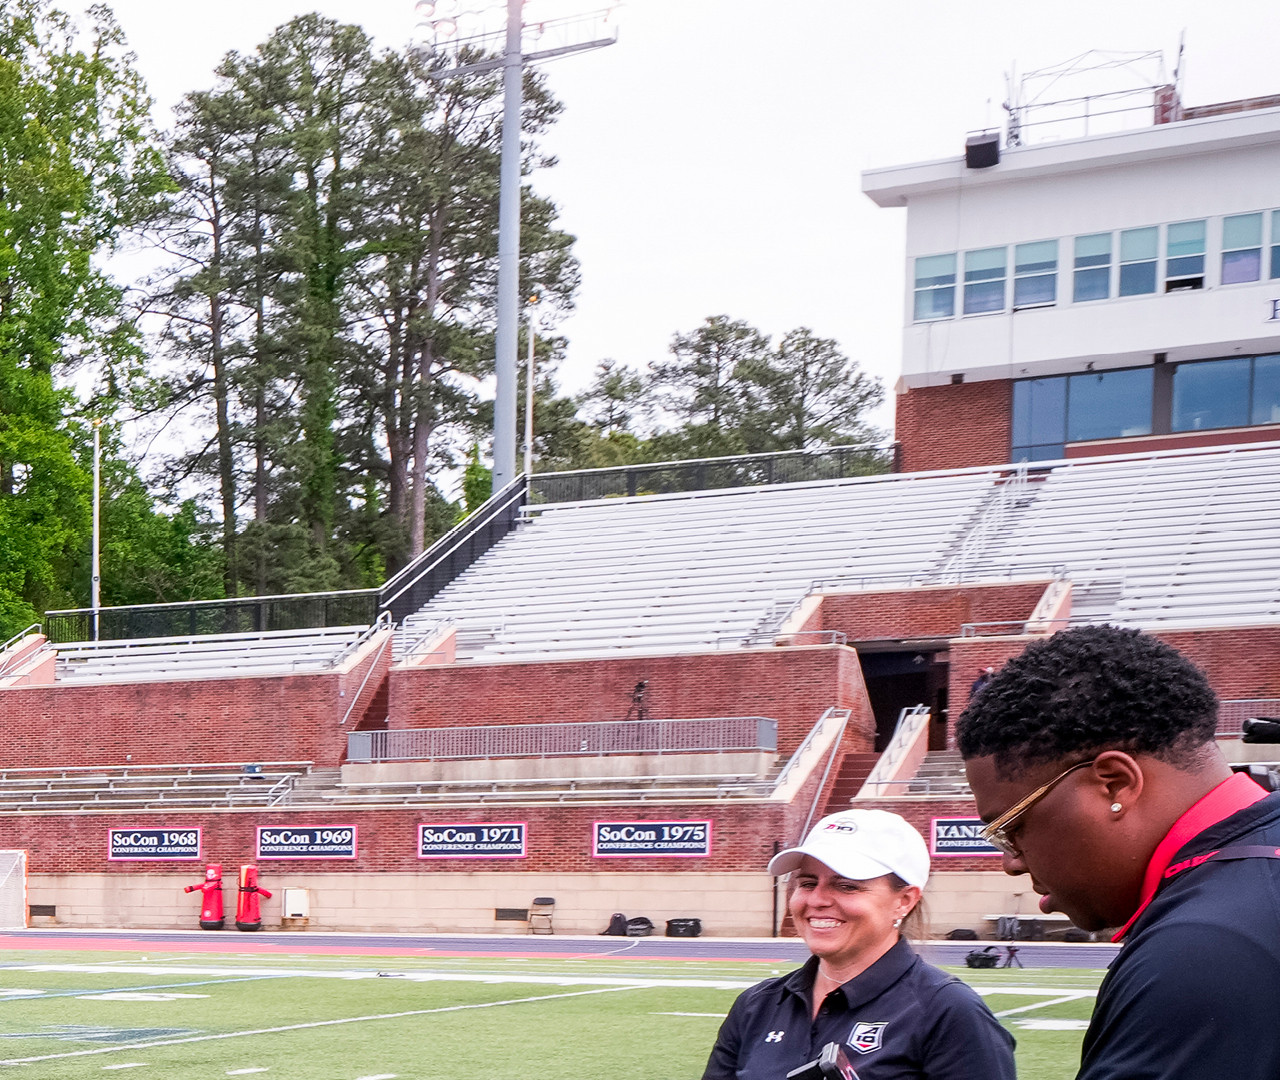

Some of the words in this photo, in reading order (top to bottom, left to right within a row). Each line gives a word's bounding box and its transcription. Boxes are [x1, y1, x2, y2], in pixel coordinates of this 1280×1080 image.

[113, 832, 159, 846] SoCon
[162, 832, 197, 846] 1968
[261, 831, 311, 845] SoCon
[315, 830, 352, 844] 1969
[423, 829, 475, 843] SoCon
[481, 828, 521, 842] 1971
[599, 827, 656, 842] SoCon
[662, 826, 705, 841] 1975
[422, 843, 474, 851] CONFERENCE
[598, 842, 654, 850] CONFERENCE
[655, 841, 706, 849] CHAMPIONS
